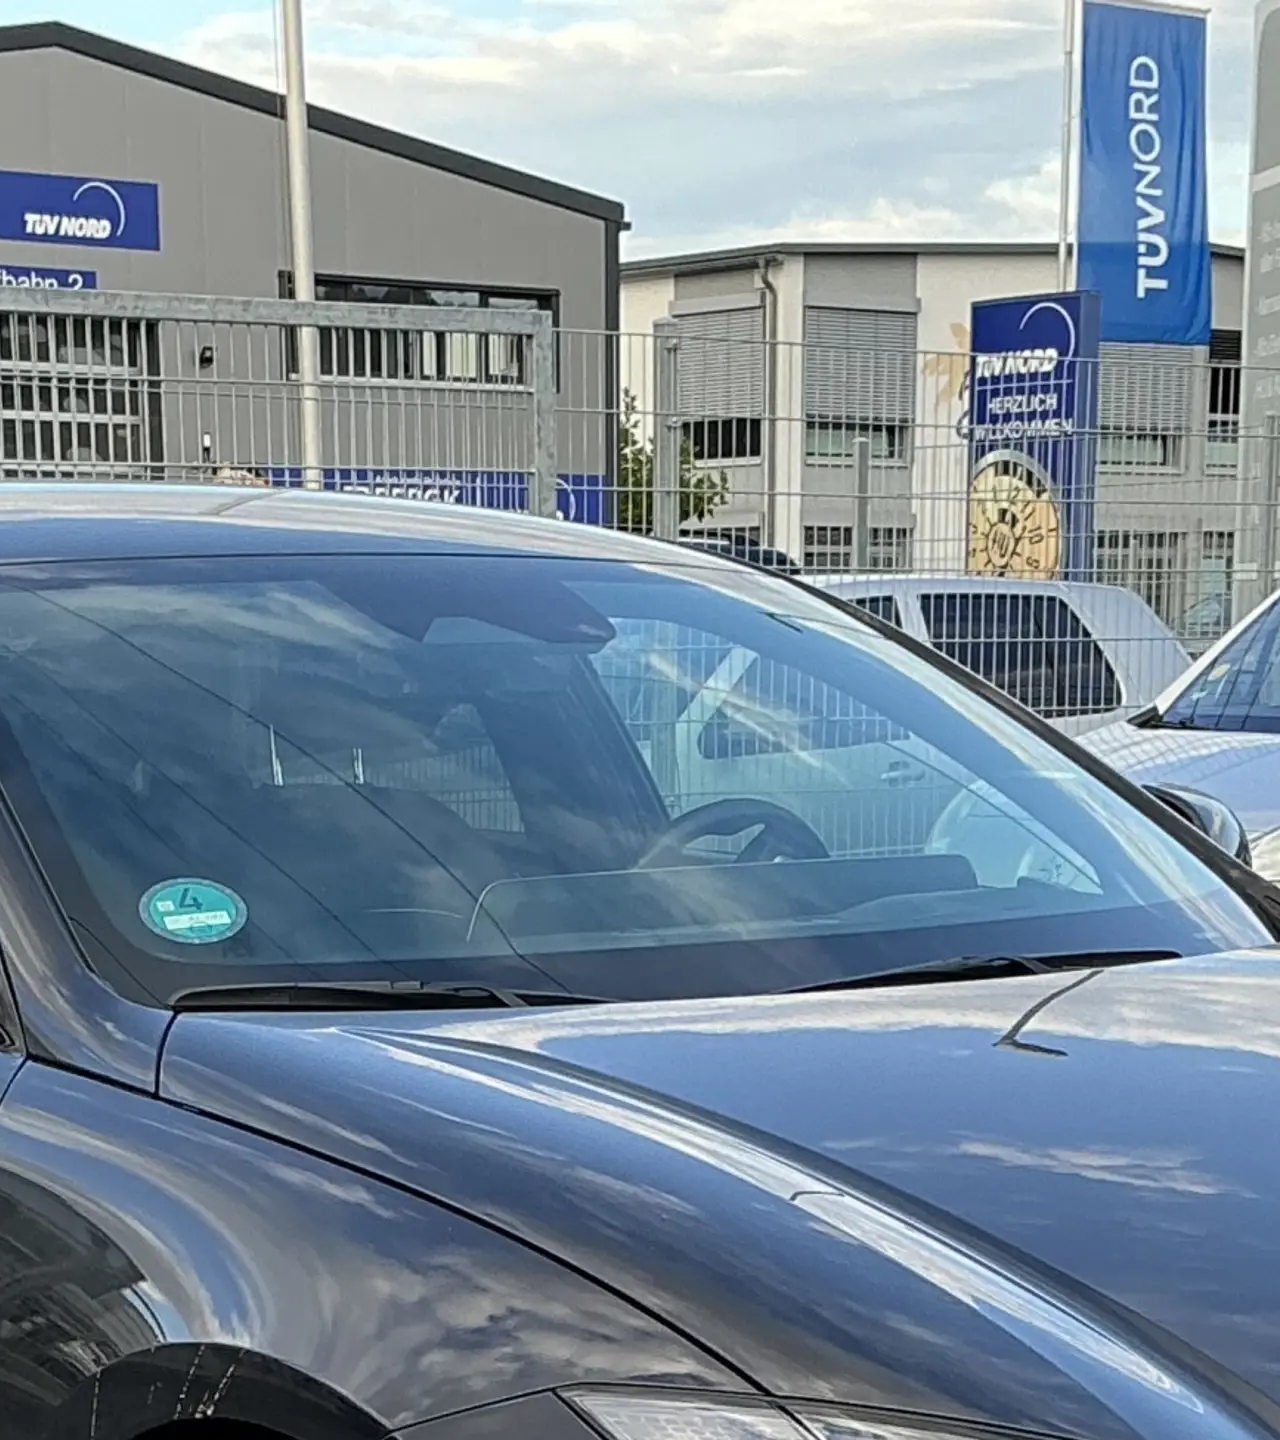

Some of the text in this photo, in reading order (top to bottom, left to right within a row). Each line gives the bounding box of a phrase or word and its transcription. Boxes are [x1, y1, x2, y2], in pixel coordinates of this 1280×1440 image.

[59, 215, 112, 240] NORD
[67, 272, 84, 291] 2
[1004, 346, 1059, 375] NORD
[987, 392, 1058, 415] HERZLICH
[179, 887, 203, 911] 4
